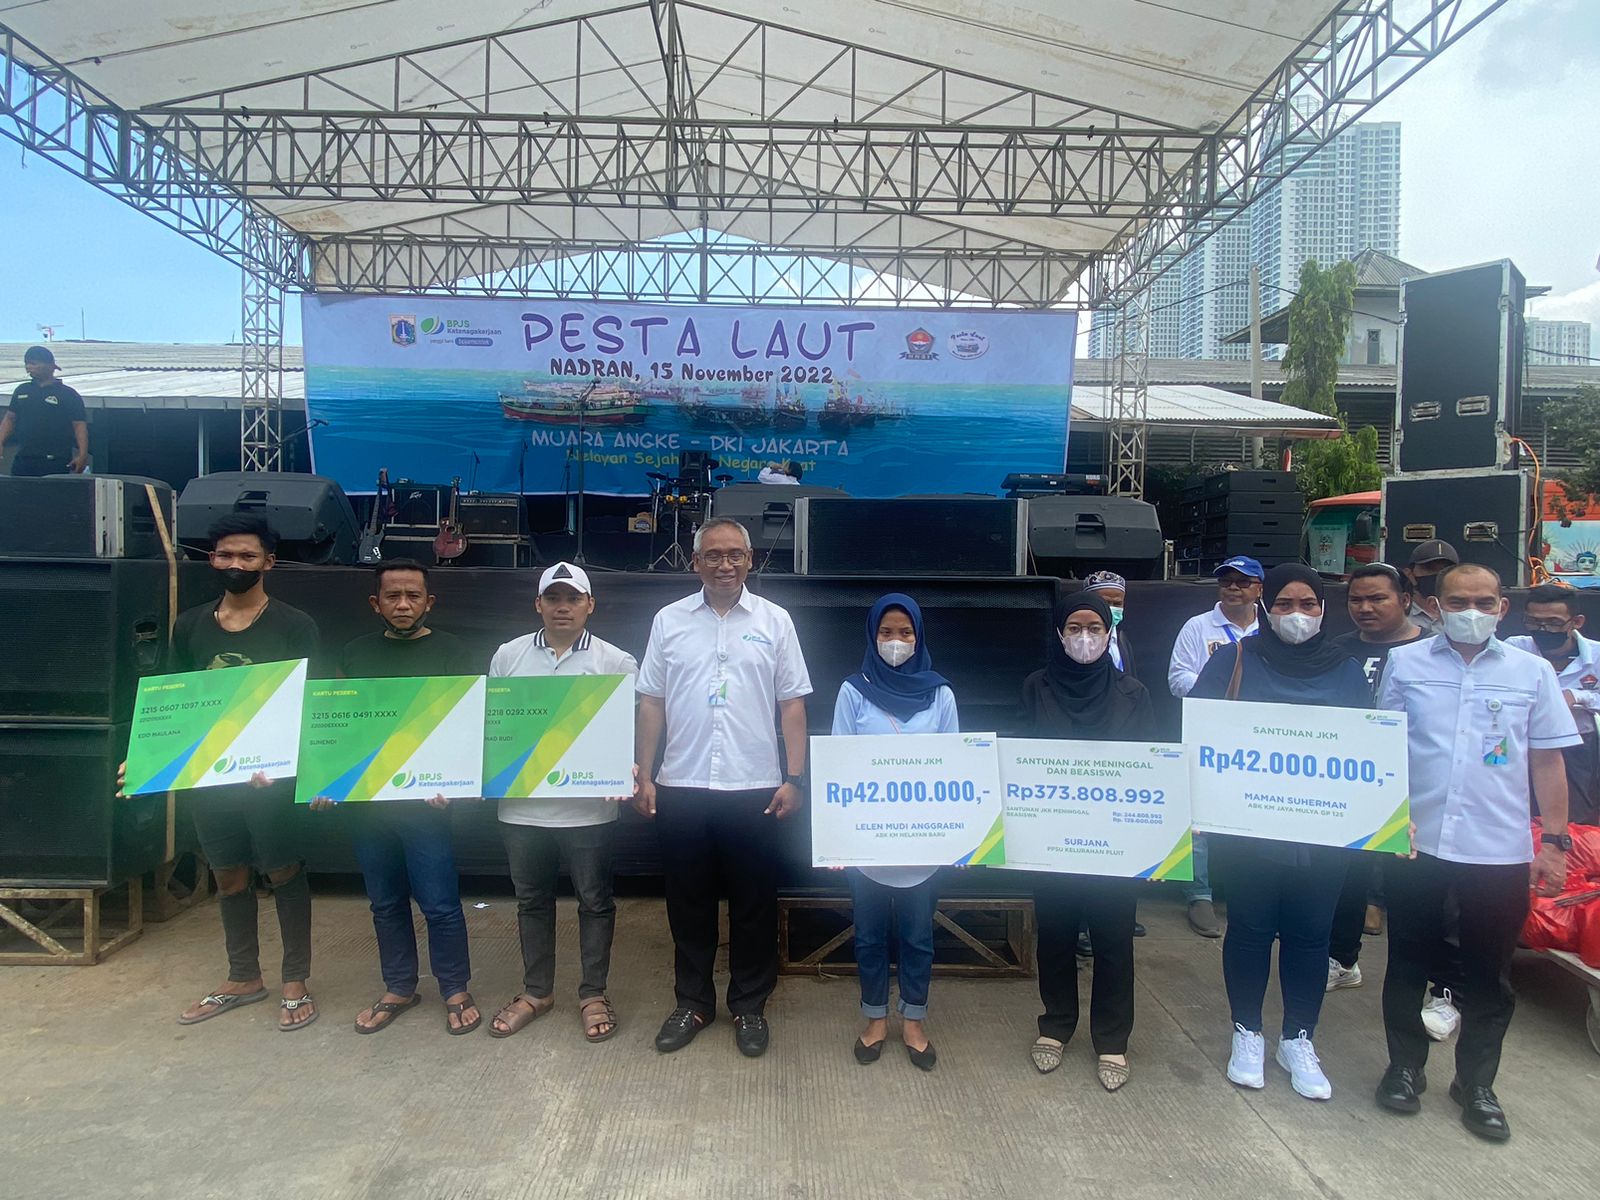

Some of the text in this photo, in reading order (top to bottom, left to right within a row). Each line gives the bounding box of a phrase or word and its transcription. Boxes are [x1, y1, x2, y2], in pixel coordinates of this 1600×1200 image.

[446, 319, 470, 328] BPJS
[521, 312, 876, 361] PESTA LAUT
[550, 358, 834, 384] NADRAN, 15 November 2022
[531, 429, 604, 447] MUARA
[613, 431, 681, 449] ANGKE
[709, 435, 743, 451] DKI
[751, 437, 849, 456] JAKARTA
[633, 452, 680, 468] Sejah
[780, 457, 816, 472] Kat
[141, 698, 222, 715] 3215 0607 1097 XXXX
[505, 708, 525, 716] 0292
[312, 710, 398, 720] 3215 0616 0491 XXXX
[1253, 726, 1339, 740] SANTUNAN JKM
[238, 760, 292, 771] Ketenagakerjaan
[239, 755, 262, 765] BPJS
[871, 757, 943, 766] SANTUNAN JKM
[1016, 757, 1154, 770] SANTUNAN JKK MENINGGAL
[1199, 745, 1395, 787] Rp42.000.000,-
[419, 773, 443, 781] BPJS
[571, 771, 594, 780] BPJS
[1046, 767, 1122, 778] DAN BEASISWA
[571, 779, 625, 787] Ketenagakerjaan
[826, 780, 990, 807] Rp42.000.000,-
[1007, 783, 1165, 805] Rp373.808.992
[1244, 792, 1347, 810] MAMAN SUHERMAN
[855, 823, 884, 831] LELEN
[910, 822, 965, 830] ANGGRAENI
[1064, 838, 1109, 848] SURJANA
[1064, 847, 1105, 855] KELURAHAN
